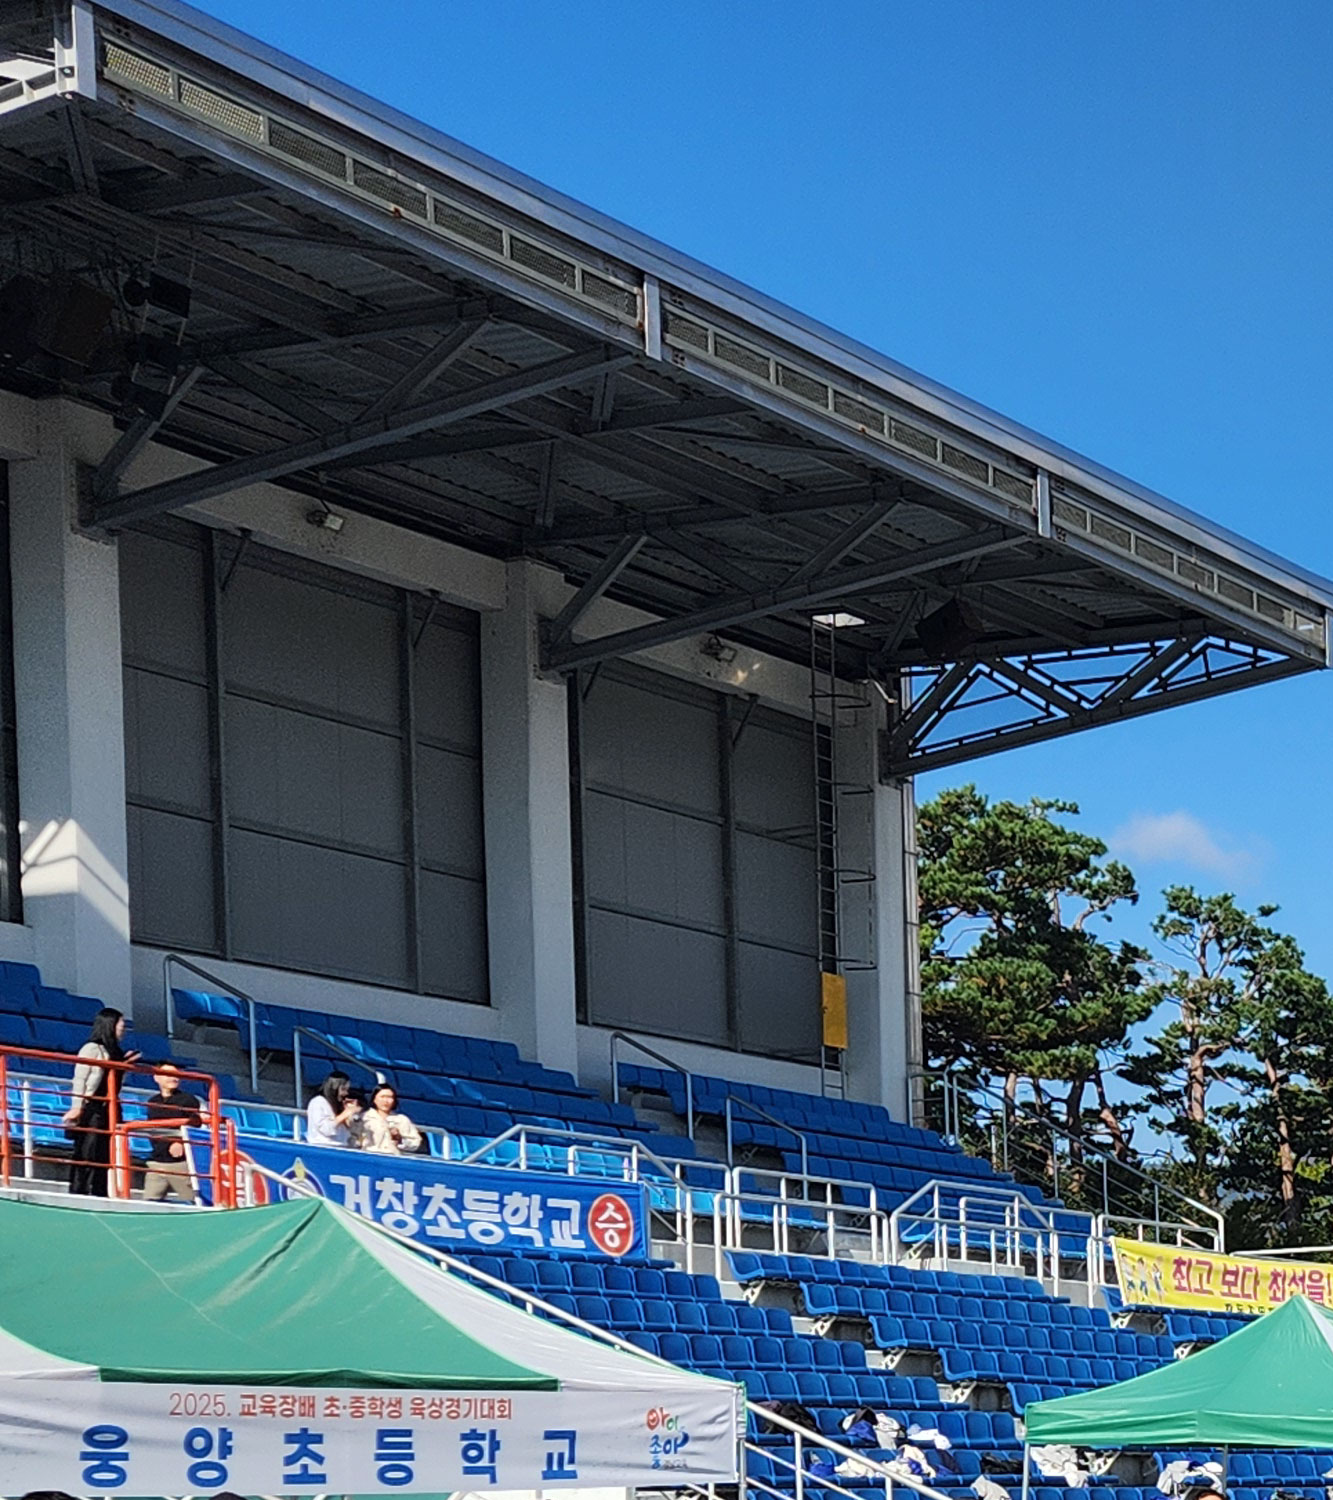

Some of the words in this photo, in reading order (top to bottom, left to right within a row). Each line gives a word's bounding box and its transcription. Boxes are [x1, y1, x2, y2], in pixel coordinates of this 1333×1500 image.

[330, 1174, 586, 1248] 거창초등학교
[595, 1204, 627, 1248] 승
[1172, 1256, 1213, 1295] 최고
[1221, 1263, 1259, 1300] 보다
[1268, 1268, 1333, 1305] 최선을!
[169, 1393, 232, 1417] 2025.
[239, 1394, 316, 1418] 교육장배
[410, 1396, 513, 1420] 육상경기대회
[79, 1424, 578, 1488] 웅양초등학교
